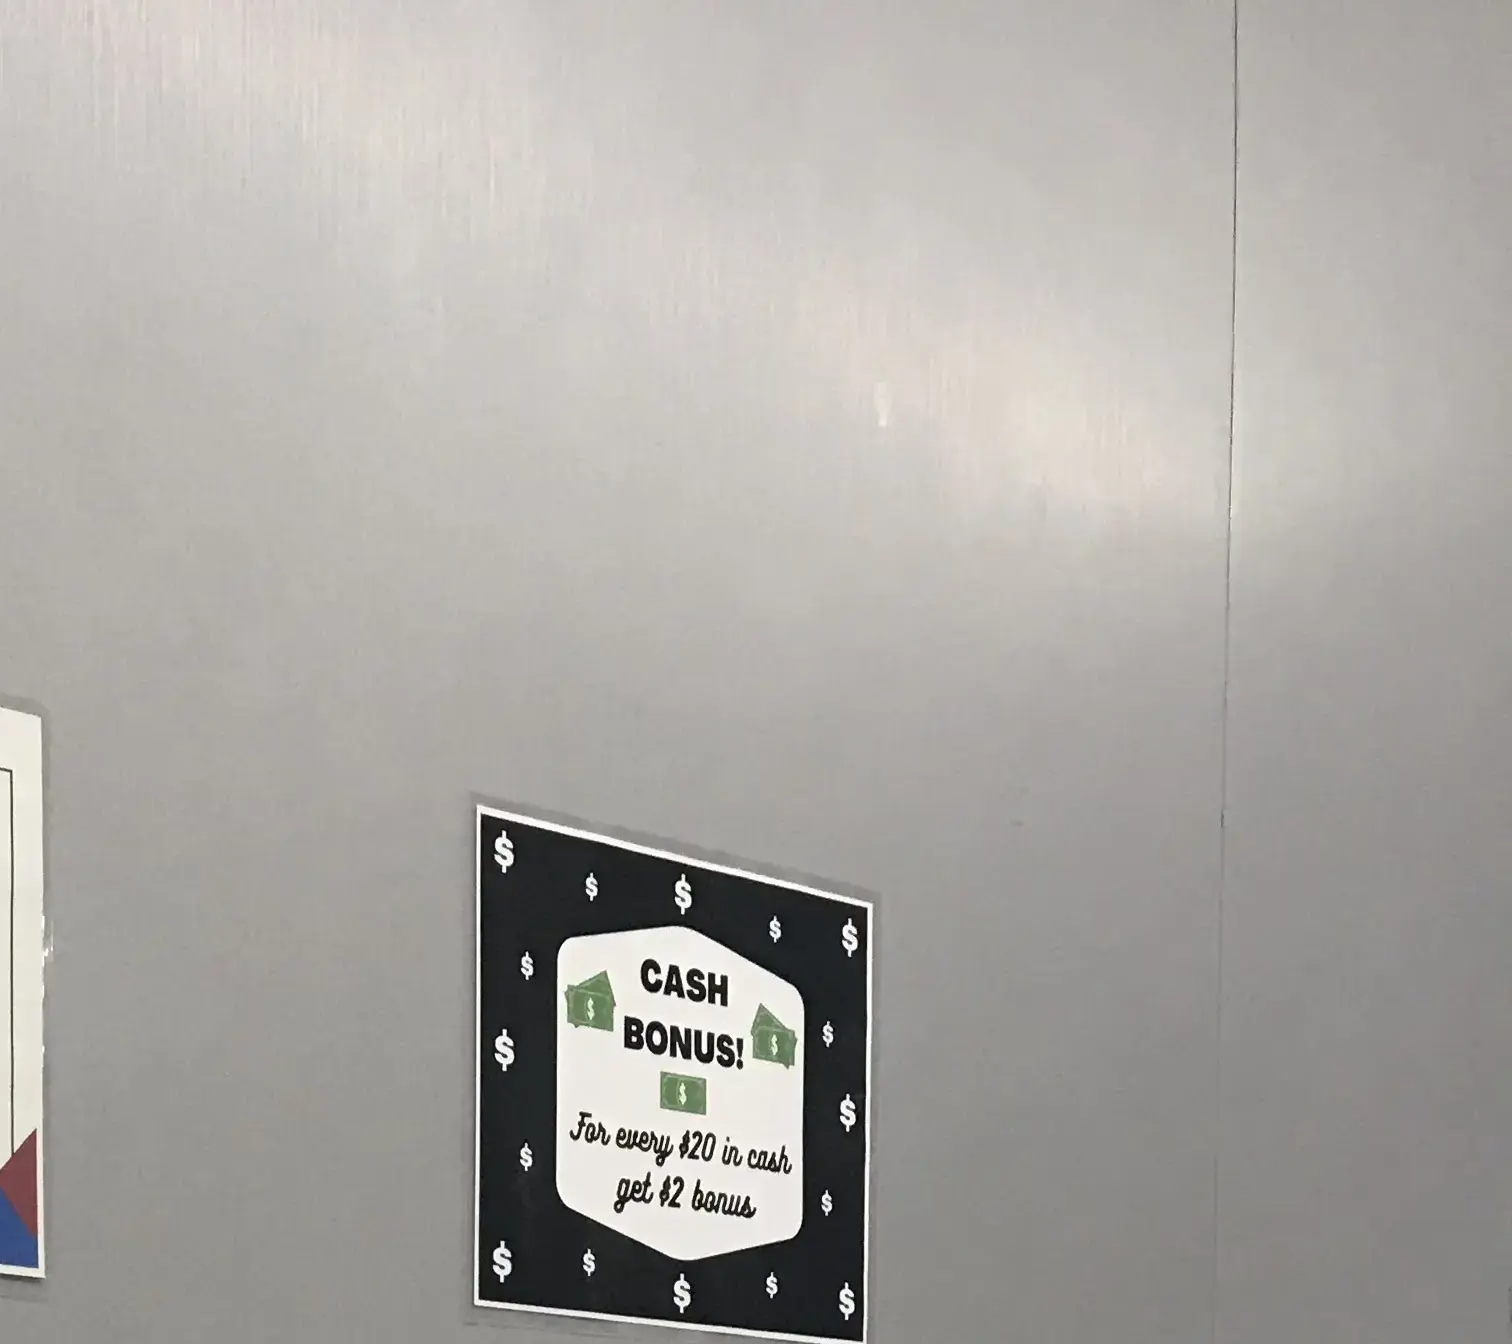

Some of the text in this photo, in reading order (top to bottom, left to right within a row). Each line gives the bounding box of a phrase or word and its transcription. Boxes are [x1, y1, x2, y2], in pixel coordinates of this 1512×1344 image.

[641, 959, 727, 1006] CASH
[624, 1016, 743, 1069] BONUS!
[570, 1112, 792, 1174] For every $20 in cash
[614, 1172, 756, 1218] get $2 bonus
